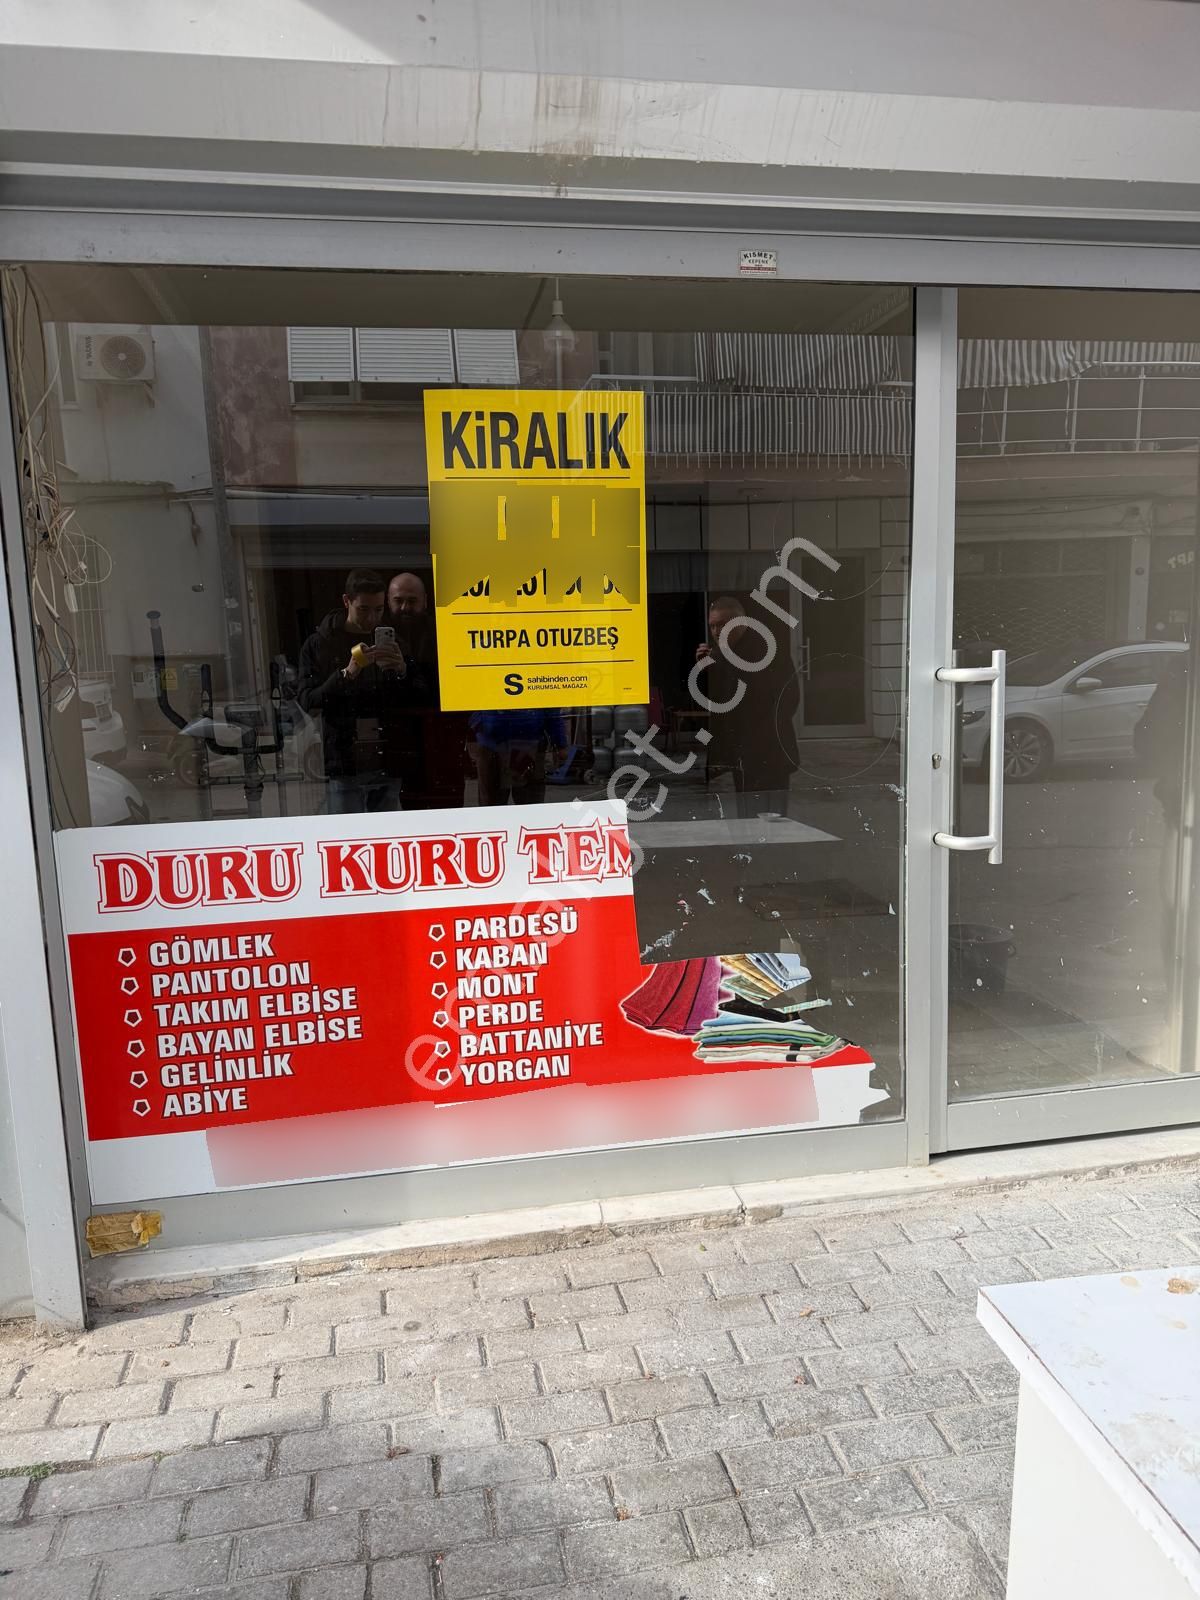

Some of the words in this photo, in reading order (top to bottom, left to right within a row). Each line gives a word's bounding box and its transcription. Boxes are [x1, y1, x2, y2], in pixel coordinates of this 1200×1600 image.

[743, 251, 773, 260] KISMET
[467, 628, 530, 649] TURPA
[536, 626, 619, 650] OTUZBEŞ
[504, 673, 524, 696] S
[527, 675, 588, 684] sahibinden.com
[93, 842, 304, 914] DURU
[316, 830, 508, 899] KURU
[453, 906, 579, 943] PARDESÜ
[148, 933, 275, 968] GÖMLEK
[455, 941, 548, 971] KABAN
[151, 961, 311, 998] PANTOLON
[456, 971, 538, 1000] MONT
[153, 997, 249, 1028] TAKIM
[258, 985, 358, 1019] ELBİSE
[458, 1000, 544, 1029] PERDE
[157, 1026, 254, 1059] BAYAN
[264, 1014, 362, 1048] ELBİSE
[459, 1019, 604, 1059] BATTANİYE
[160, 1049, 294, 1089] GELİNLİK
[460, 1055, 571, 1088] YORGAN
[161, 1085, 249, 1118] ABİYE
